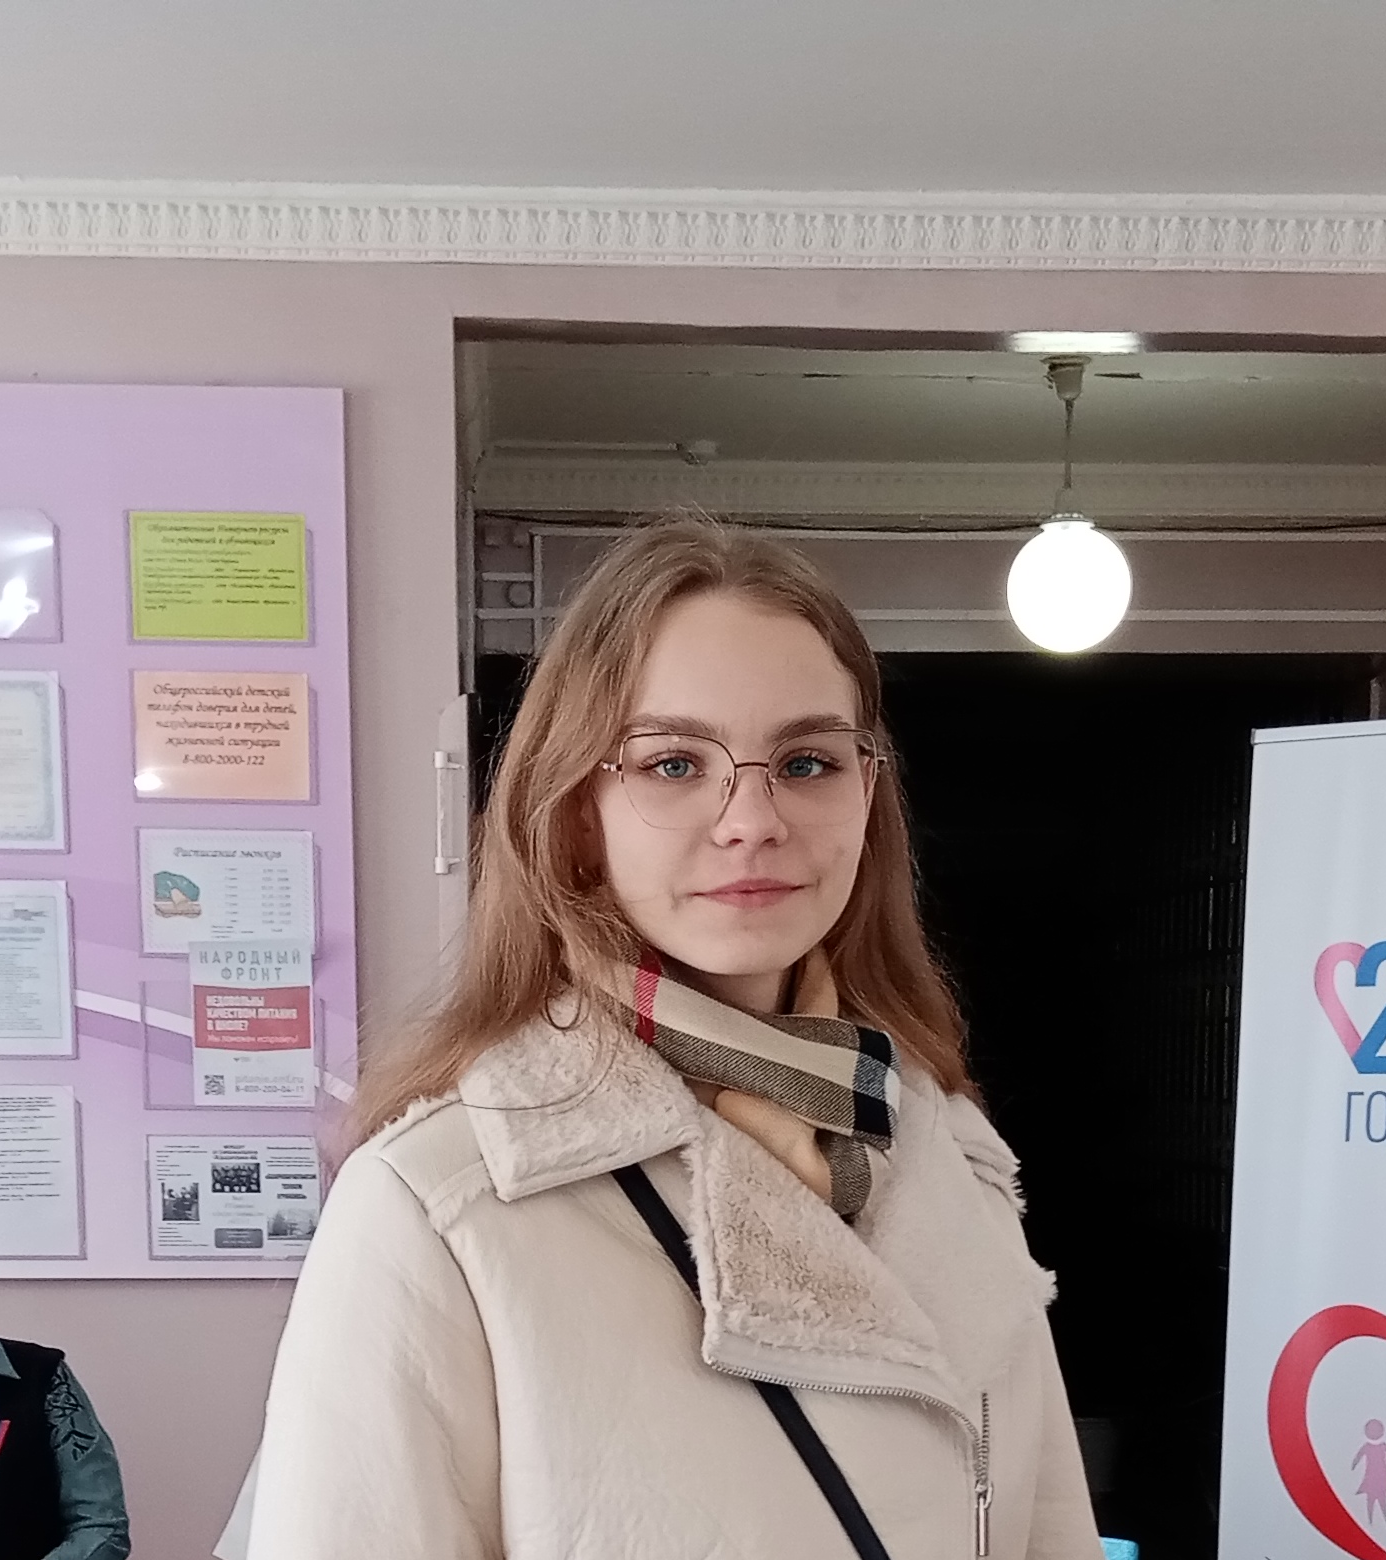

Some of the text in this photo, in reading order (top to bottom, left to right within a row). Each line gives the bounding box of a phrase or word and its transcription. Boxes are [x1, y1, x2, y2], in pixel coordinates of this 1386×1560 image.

[182, 754, 264, 766] 8-800-2000-122
[199, 948, 301, 966] НАРОДНЫЙ
[220, 966, 283, 981] ФРОНТ
